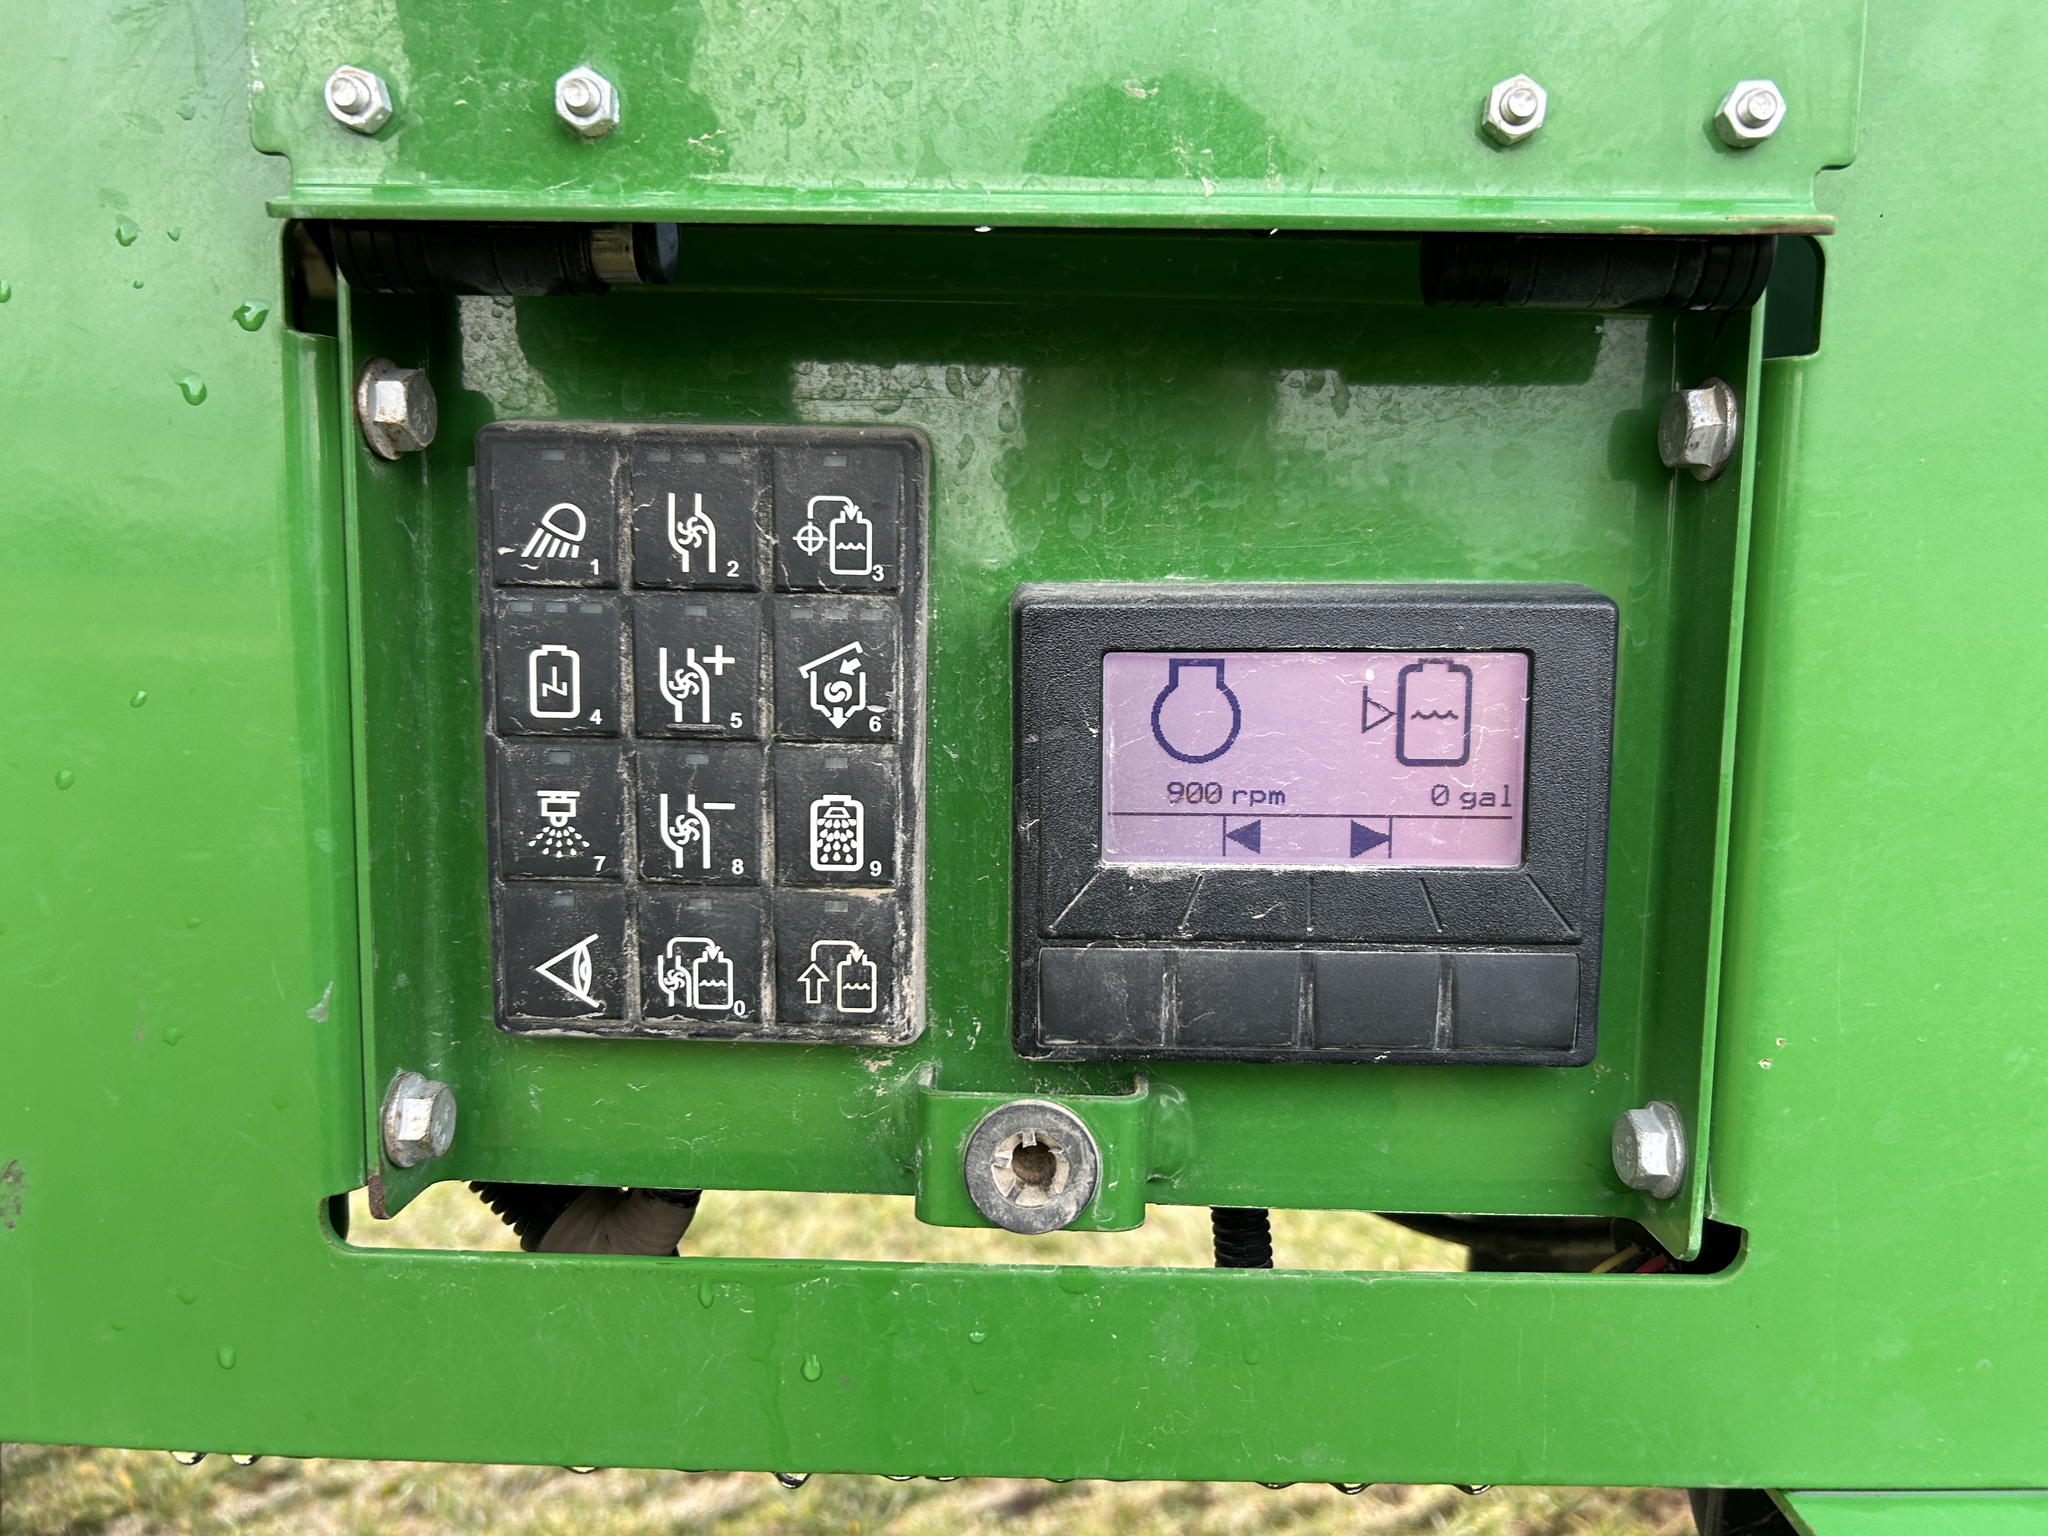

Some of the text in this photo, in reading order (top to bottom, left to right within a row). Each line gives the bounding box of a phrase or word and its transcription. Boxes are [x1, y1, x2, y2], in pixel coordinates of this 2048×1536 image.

[590, 558, 600, 576] 1
[726, 559, 740, 578] 2
[871, 563, 884, 582] 3
[588, 708, 603, 725] 4
[729, 711, 744, 729] 5
[868, 715, 882, 733] 6
[1166, 781, 1286, 807] 900 rpm
[1431, 783, 1512, 810] 0 gal
[593, 855, 607, 872] 7
[731, 858, 745, 876] 8
[869, 860, 883, 877] 9
[734, 1000, 746, 1015] 0
